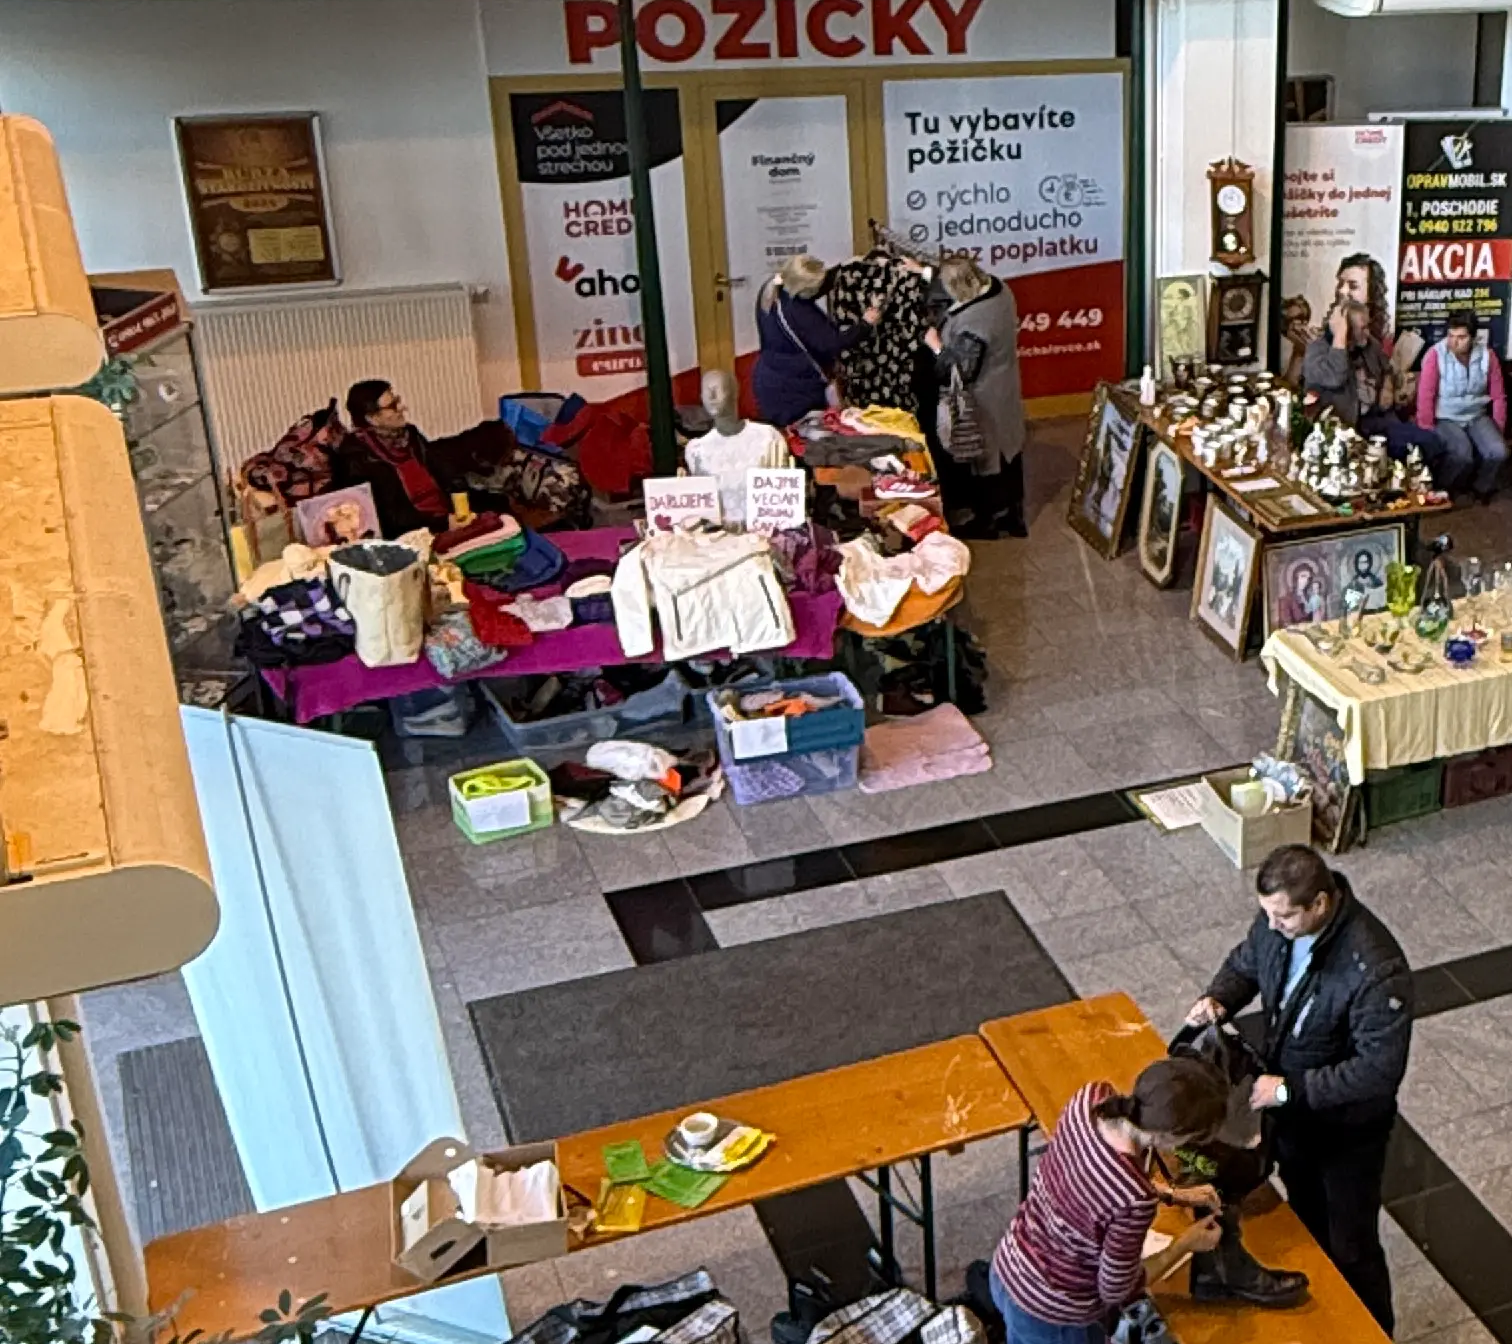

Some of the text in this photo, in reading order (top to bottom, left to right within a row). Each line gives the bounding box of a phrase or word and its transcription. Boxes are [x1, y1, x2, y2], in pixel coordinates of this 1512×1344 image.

[904, 104, 1075, 139] Tu vybavíte
[533, 125, 593, 141] Všetko
[536, 142, 571, 160] pod
[908, 137, 1022, 173] pôžičku
[537, 160, 613, 176] strechou
[1407, 173, 1508, 189] OPRAVMOBIL.SK
[937, 182, 1011, 212] rýchlo
[1421, 199, 1499, 216] POSCHODIE
[563, 199, 632, 219] HOM
[565, 217, 632, 238] CRED
[936, 207, 1082, 242] jednoducho
[990, 234, 1098, 265] poplatku
[1400, 242, 1495, 282] AKCIA
[574, 269, 641, 298] aho
[1056, 308, 1103, 330] 449
[1016, 340, 1101, 358] ichalovce.sk
